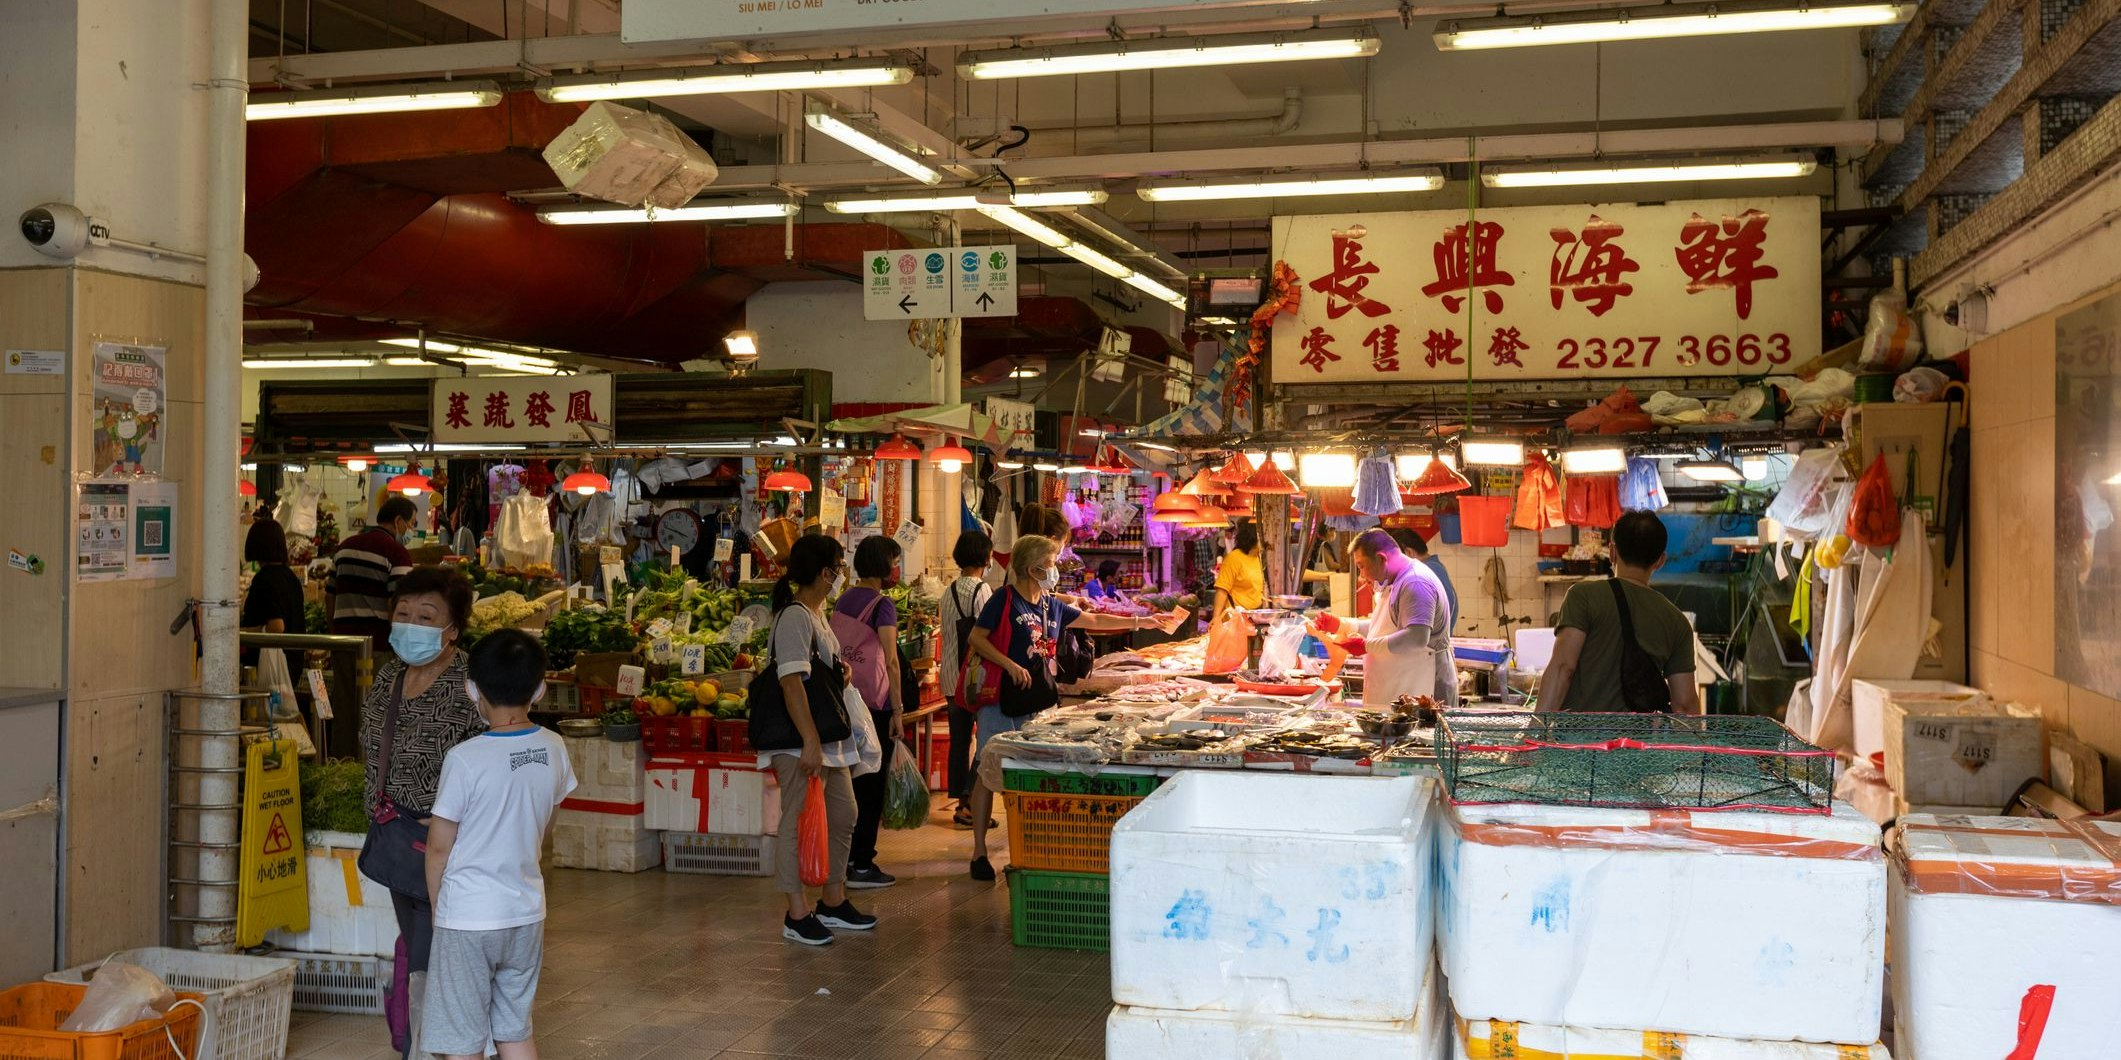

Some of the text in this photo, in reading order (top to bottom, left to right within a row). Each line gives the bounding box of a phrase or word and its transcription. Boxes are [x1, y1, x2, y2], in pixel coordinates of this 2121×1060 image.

[738, 3, 754, 13] SIU
[757, 1, 776, 12] MEI
[787, 0, 801, 10] LO
[803, 0, 823, 8] MEI
[90, 224, 110, 239] CCTV
[1309, 208, 1778, 320] 長興海鮮
[1300, 323, 1792, 373] 零售批發 2327 3663
[1919, 723, 1946, 739] S117
[1963, 746, 1990, 759] S117
[262, 788, 290, 800] CAUTION
[259, 798, 294, 811] WET FLOOR
[257, 856, 298, 883] 小心地滑
